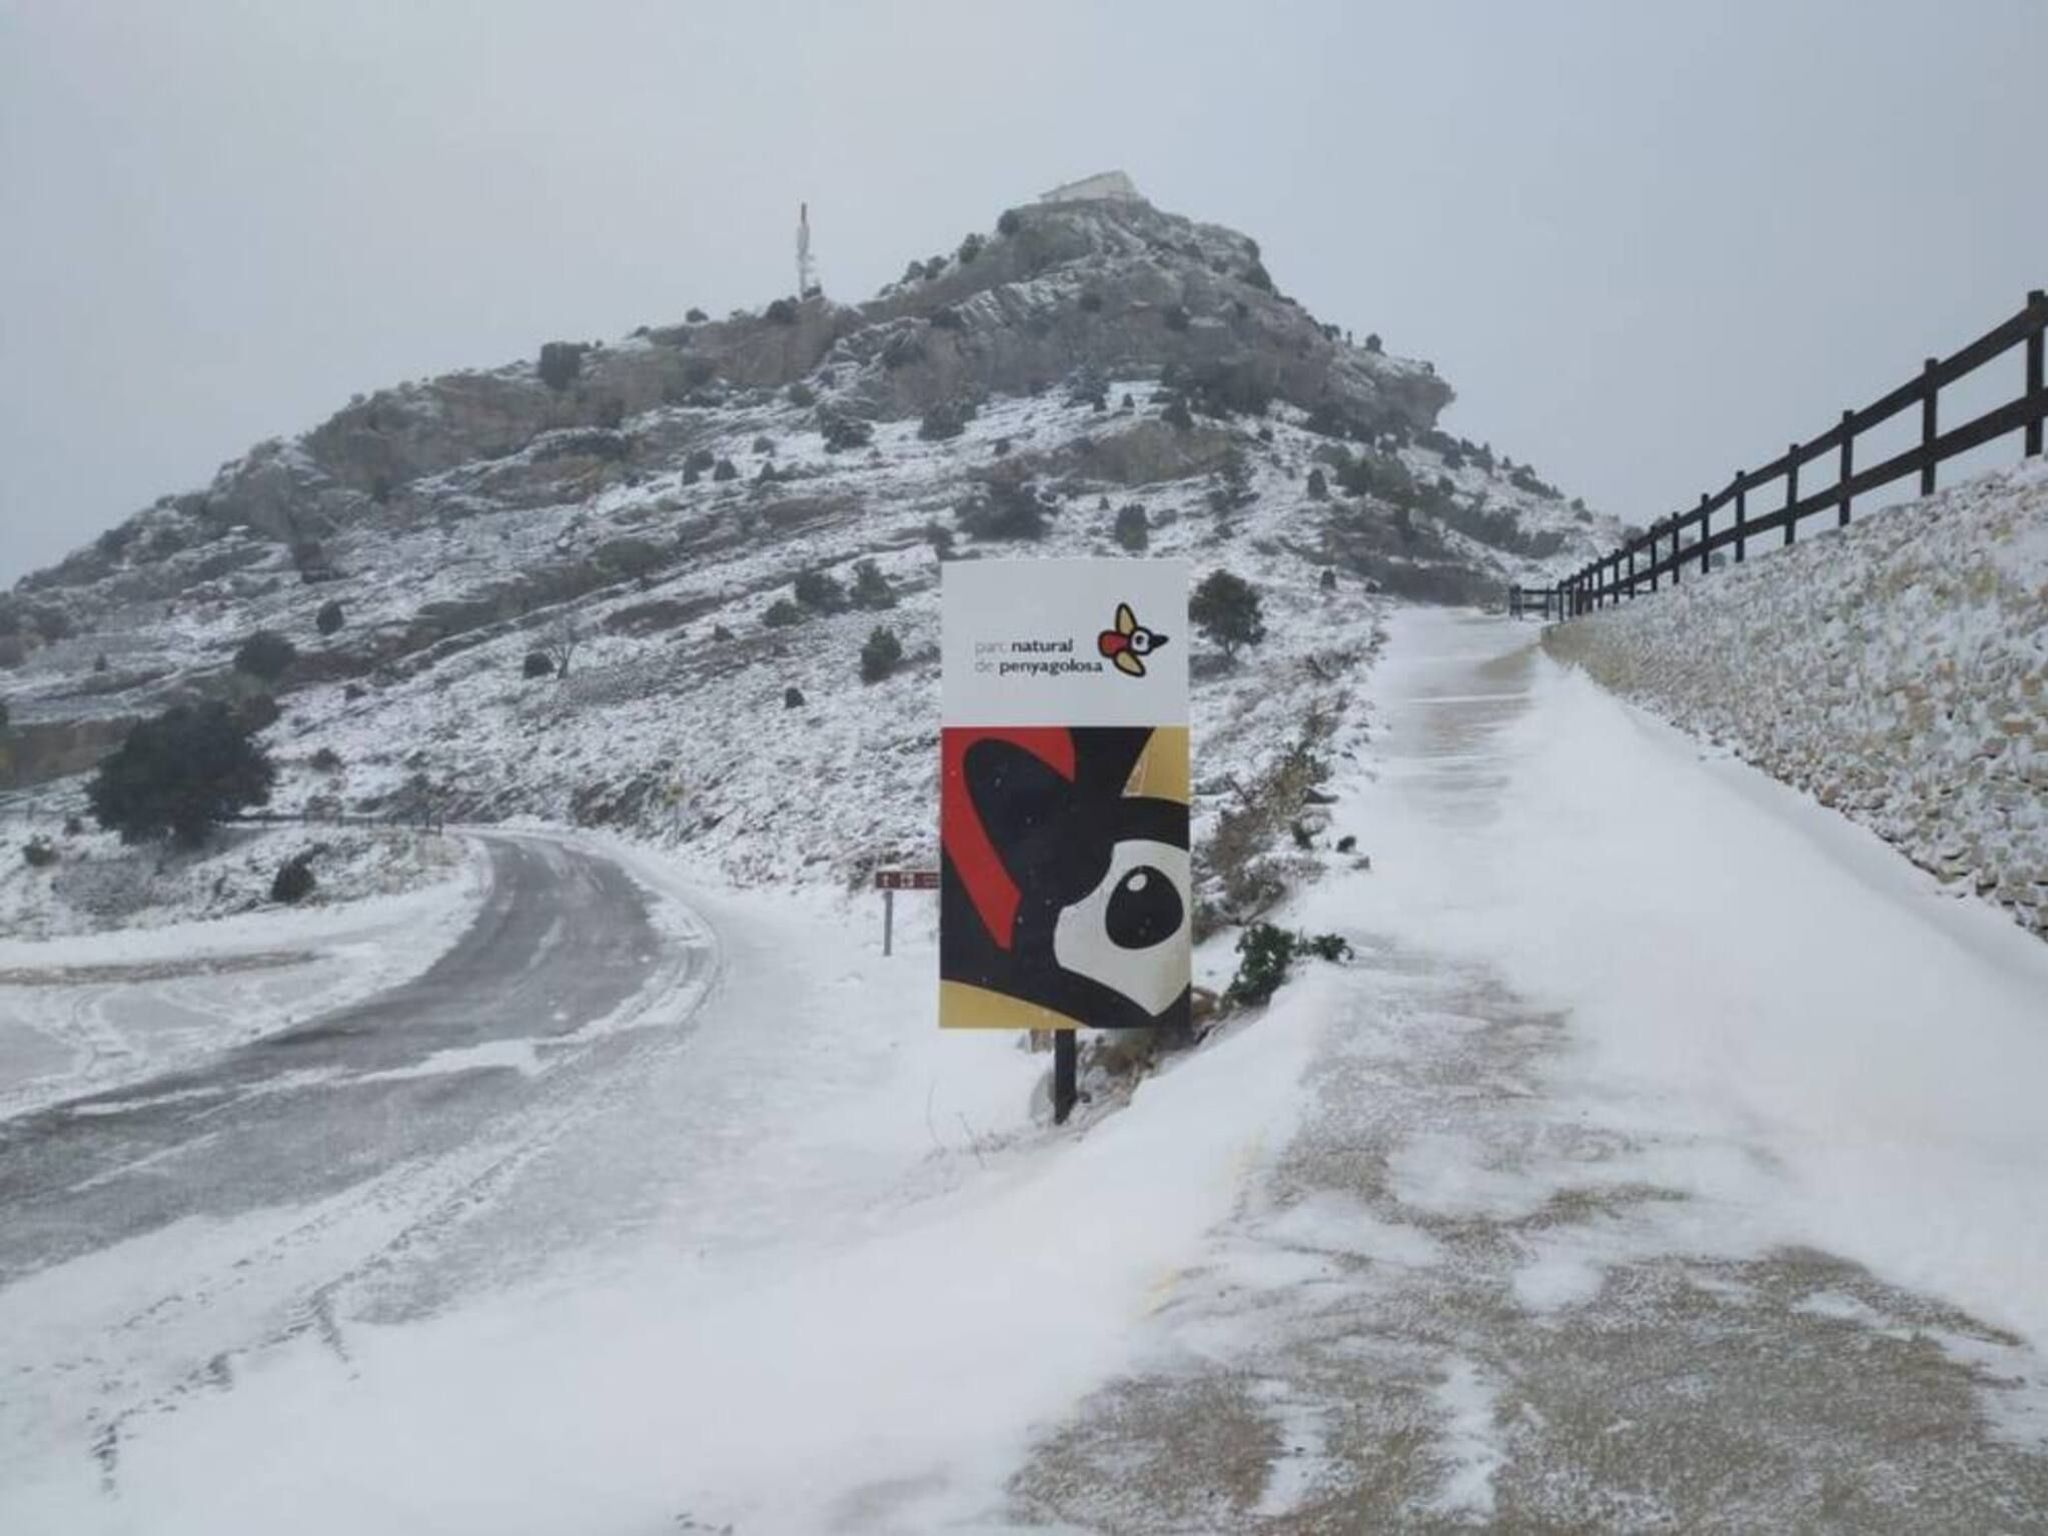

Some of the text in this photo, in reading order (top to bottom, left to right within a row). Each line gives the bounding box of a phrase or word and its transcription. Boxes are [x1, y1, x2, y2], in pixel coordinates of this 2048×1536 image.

[974, 638, 1074, 656] parc natural
[974, 658, 1104, 677] de penyagolosa
